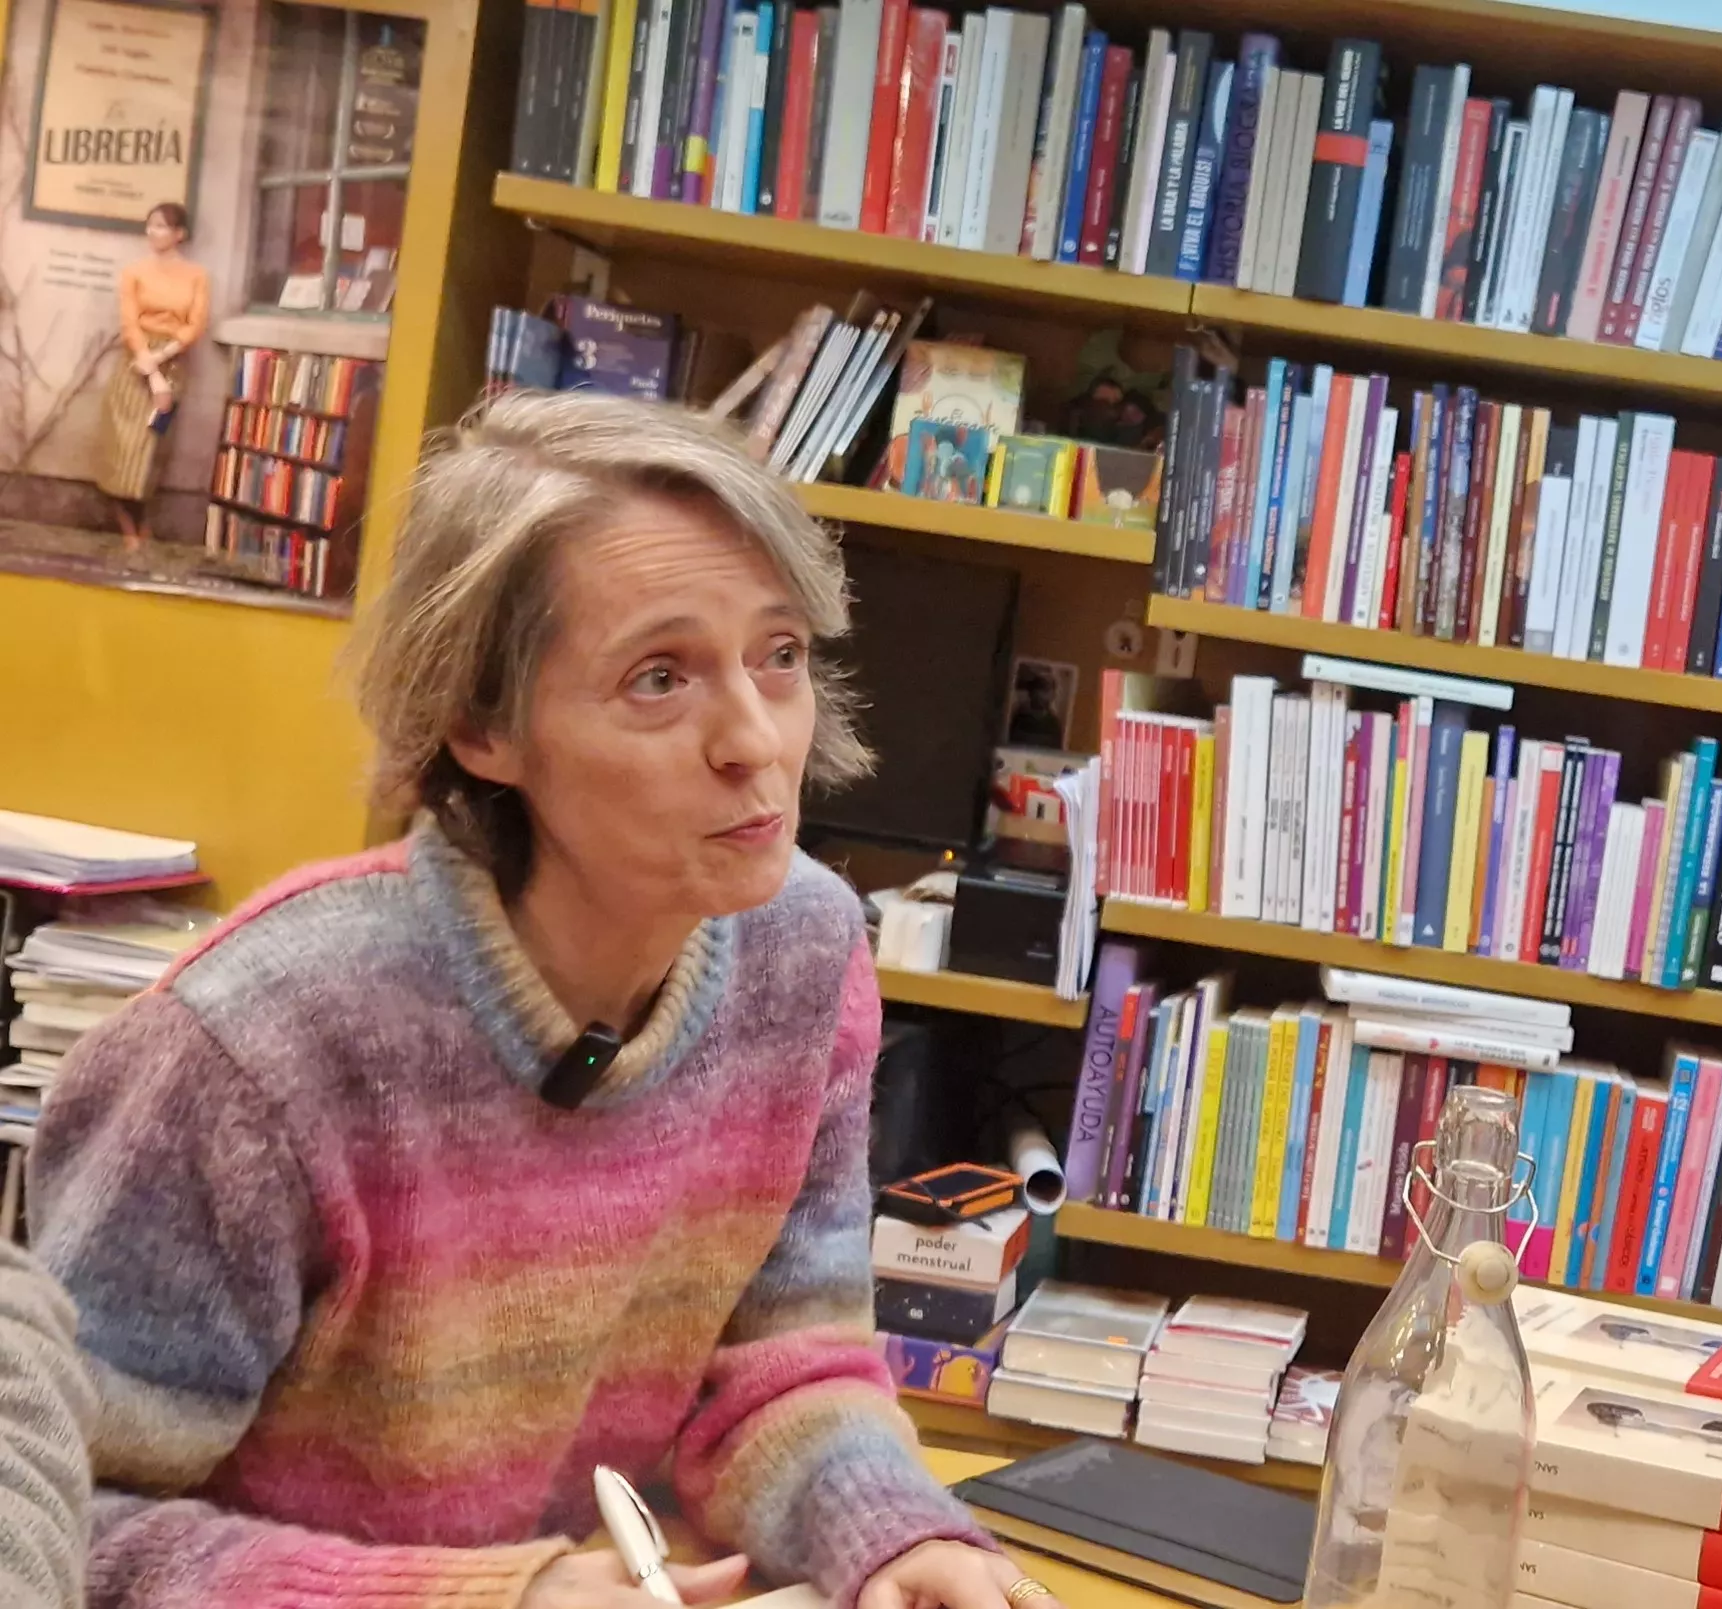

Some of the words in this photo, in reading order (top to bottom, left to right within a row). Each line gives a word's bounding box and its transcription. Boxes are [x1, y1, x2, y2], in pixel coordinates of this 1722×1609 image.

[44, 117, 183, 165] LIBRERÍA
[1074, 1004, 1122, 1146] AUTOAYUDA
[915, 1235, 958, 1252] poder
